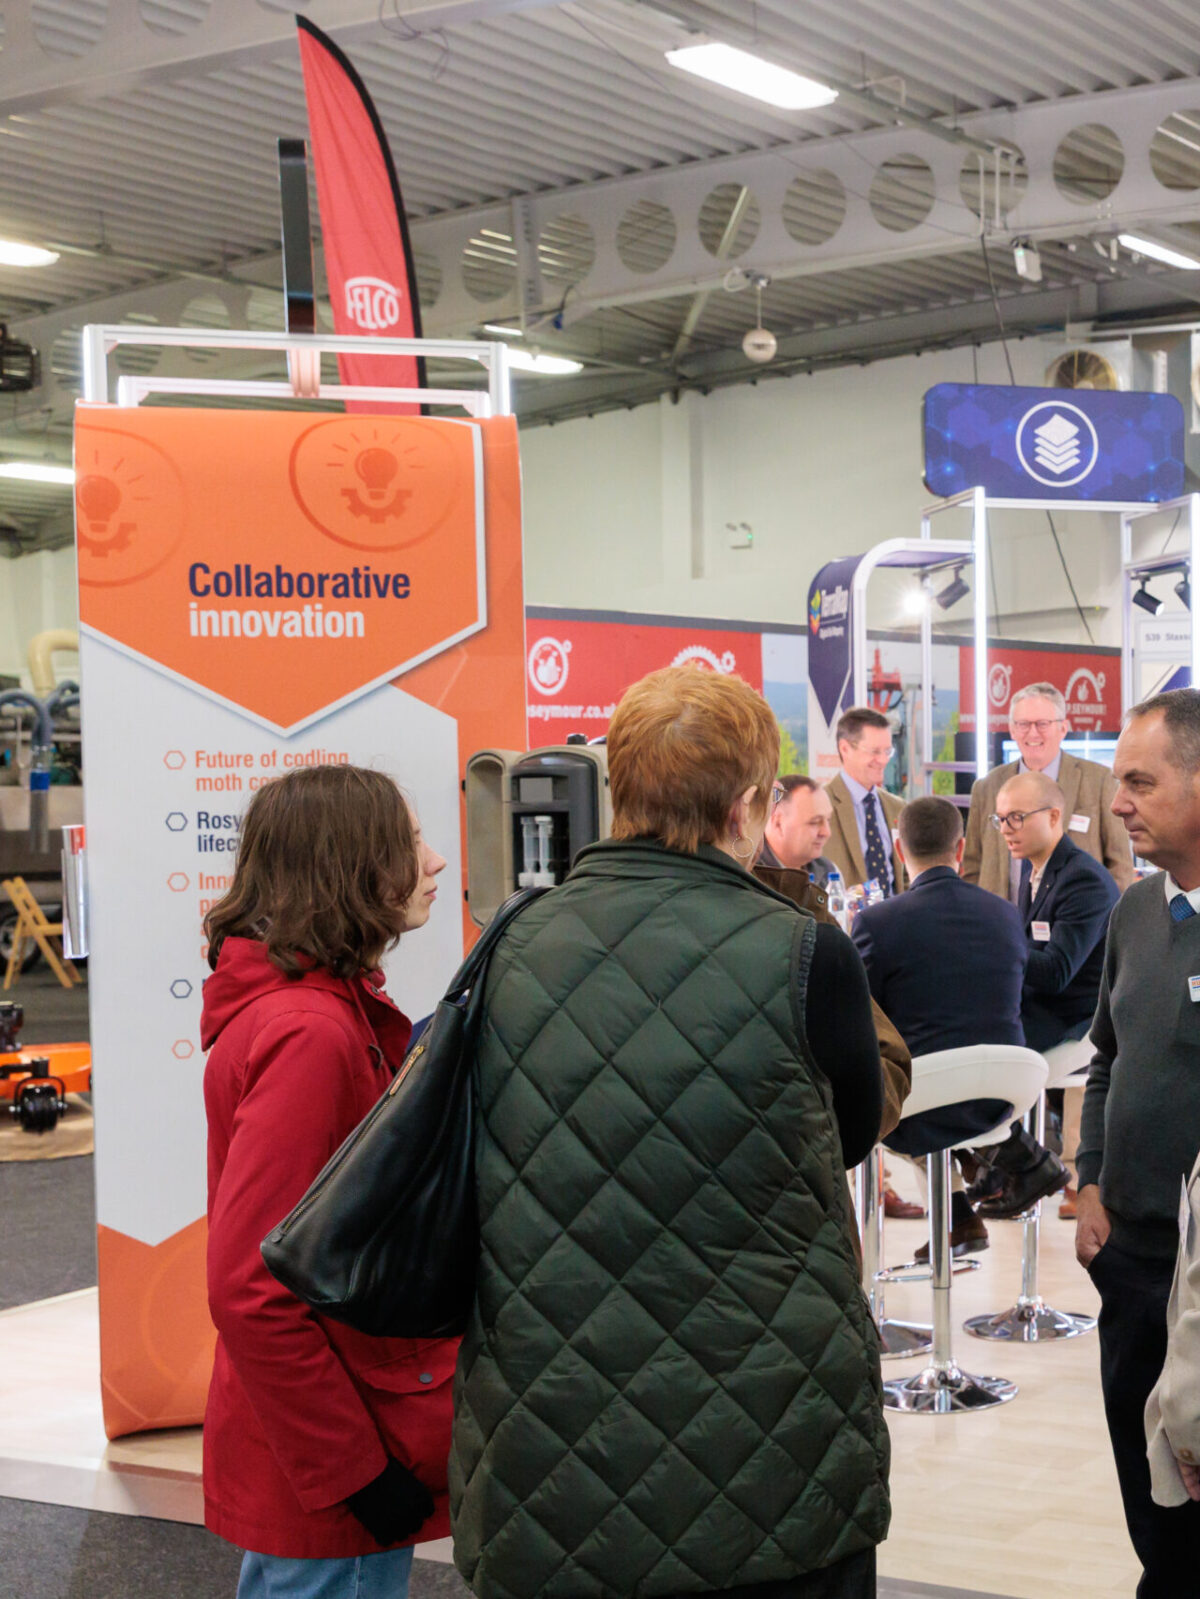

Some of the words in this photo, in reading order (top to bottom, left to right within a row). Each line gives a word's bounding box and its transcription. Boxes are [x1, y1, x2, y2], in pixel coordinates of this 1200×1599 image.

[345, 276, 399, 329] FELCO
[189, 562, 411, 599] Collaborative
[189, 602, 365, 638] innovation
[527, 703, 616, 721] seymour.co.u
[195, 750, 254, 768] Future
[260, 749, 277, 768] of
[283, 749, 349, 768] codling
[196, 773, 242, 792] moth
[197, 811, 242, 832] Rosy
